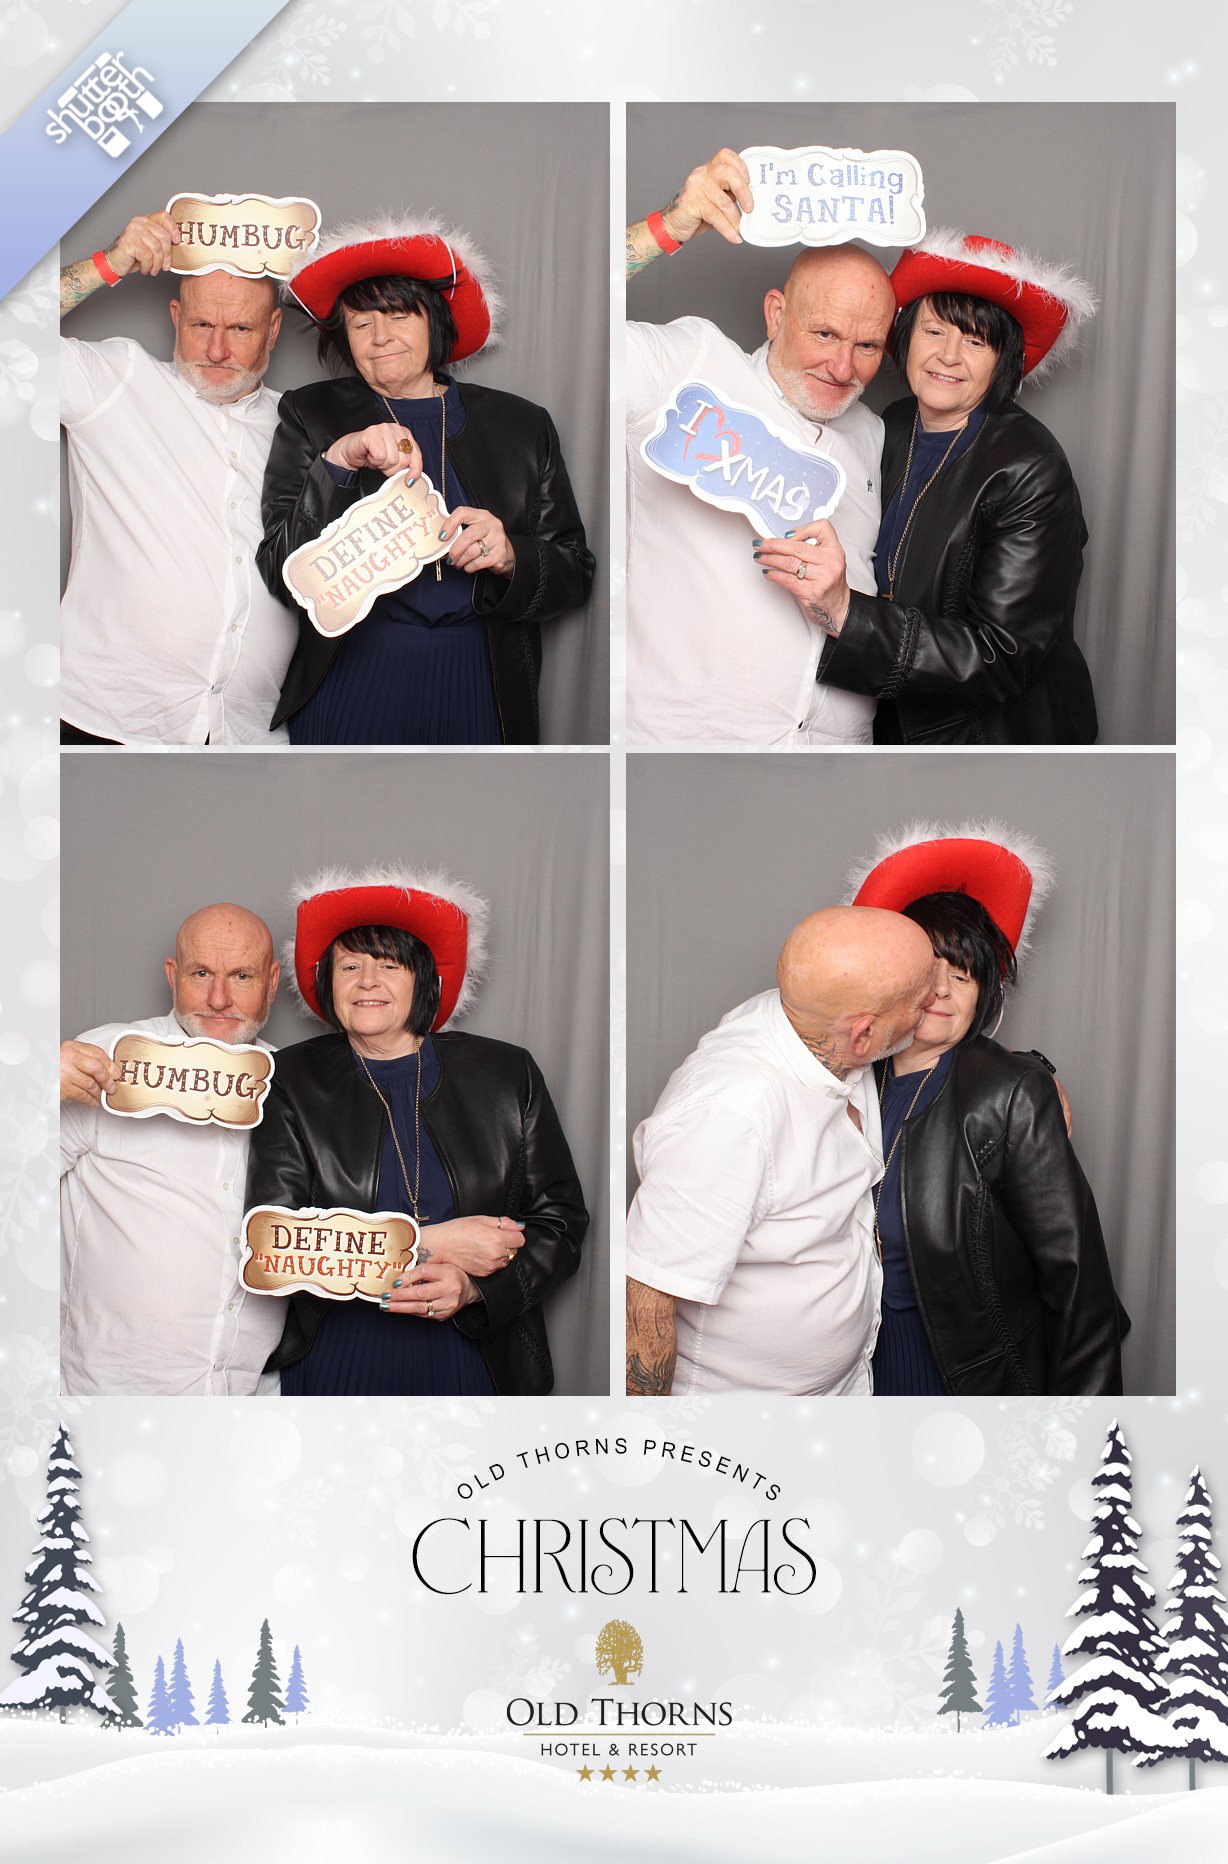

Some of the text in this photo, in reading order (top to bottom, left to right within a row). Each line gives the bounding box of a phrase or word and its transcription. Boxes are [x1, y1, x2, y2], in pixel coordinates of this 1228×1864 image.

[759, 162, 903, 194] I'm Calling
[771, 194, 895, 225] SANTA!
[175, 221, 306, 250] HUMBUG
[678, 399, 811, 521] I XMAS
[309, 494, 415, 583] DEFINE
[316, 508, 437, 609] "NAUGHTY"
[119, 1059, 258, 1099] HUMBUG
[271, 1224, 388, 1256] DEFINE
[254, 1253, 402, 1280] "NAUGHTY"
